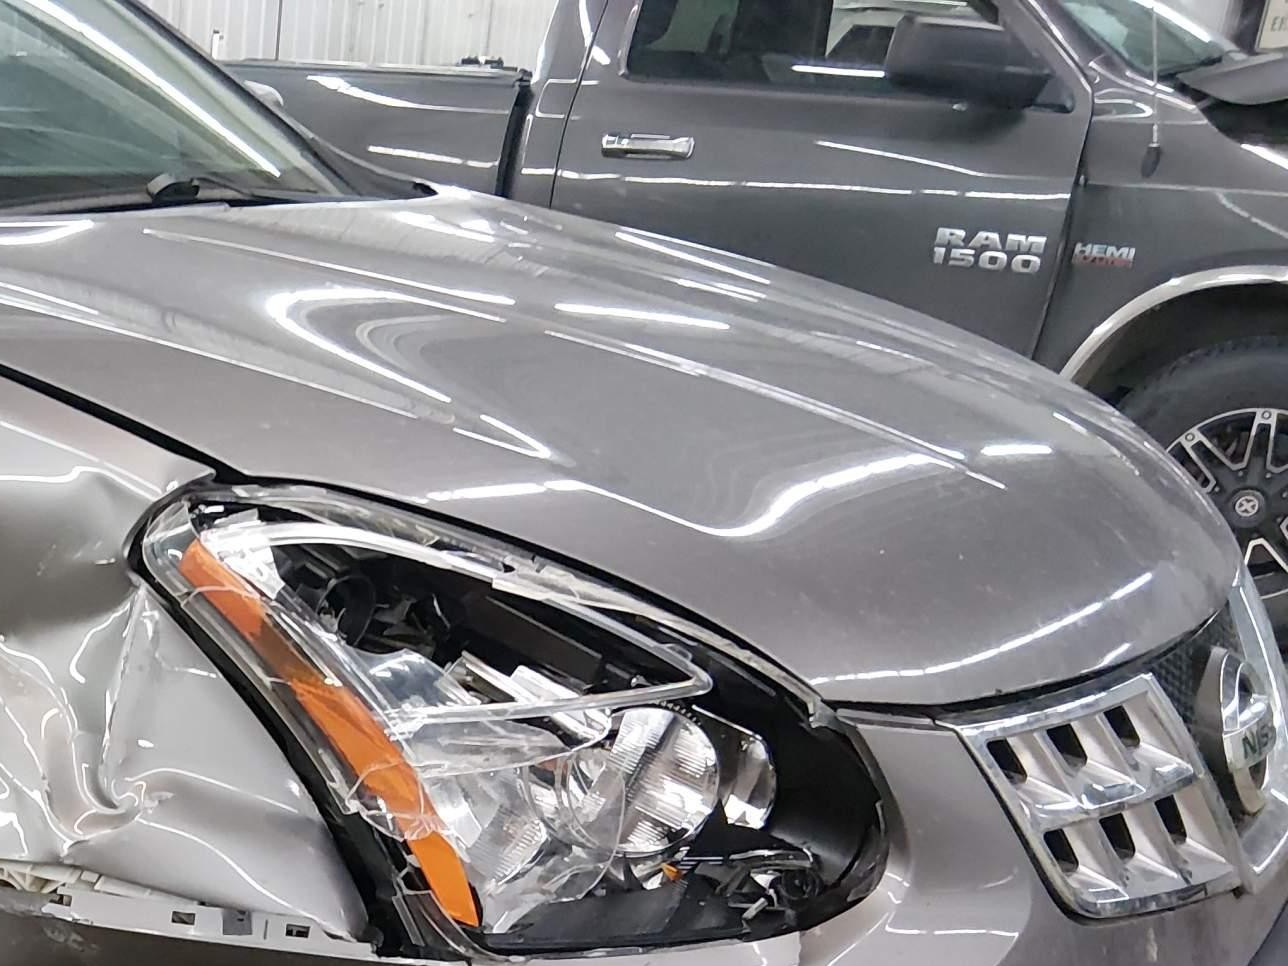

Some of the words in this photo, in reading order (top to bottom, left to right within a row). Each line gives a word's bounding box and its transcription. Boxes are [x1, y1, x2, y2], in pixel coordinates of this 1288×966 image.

[934, 227, 1048, 254] RAM
[1072, 242, 1136, 261] HEMI
[932, 246, 1041, 273] 1500
